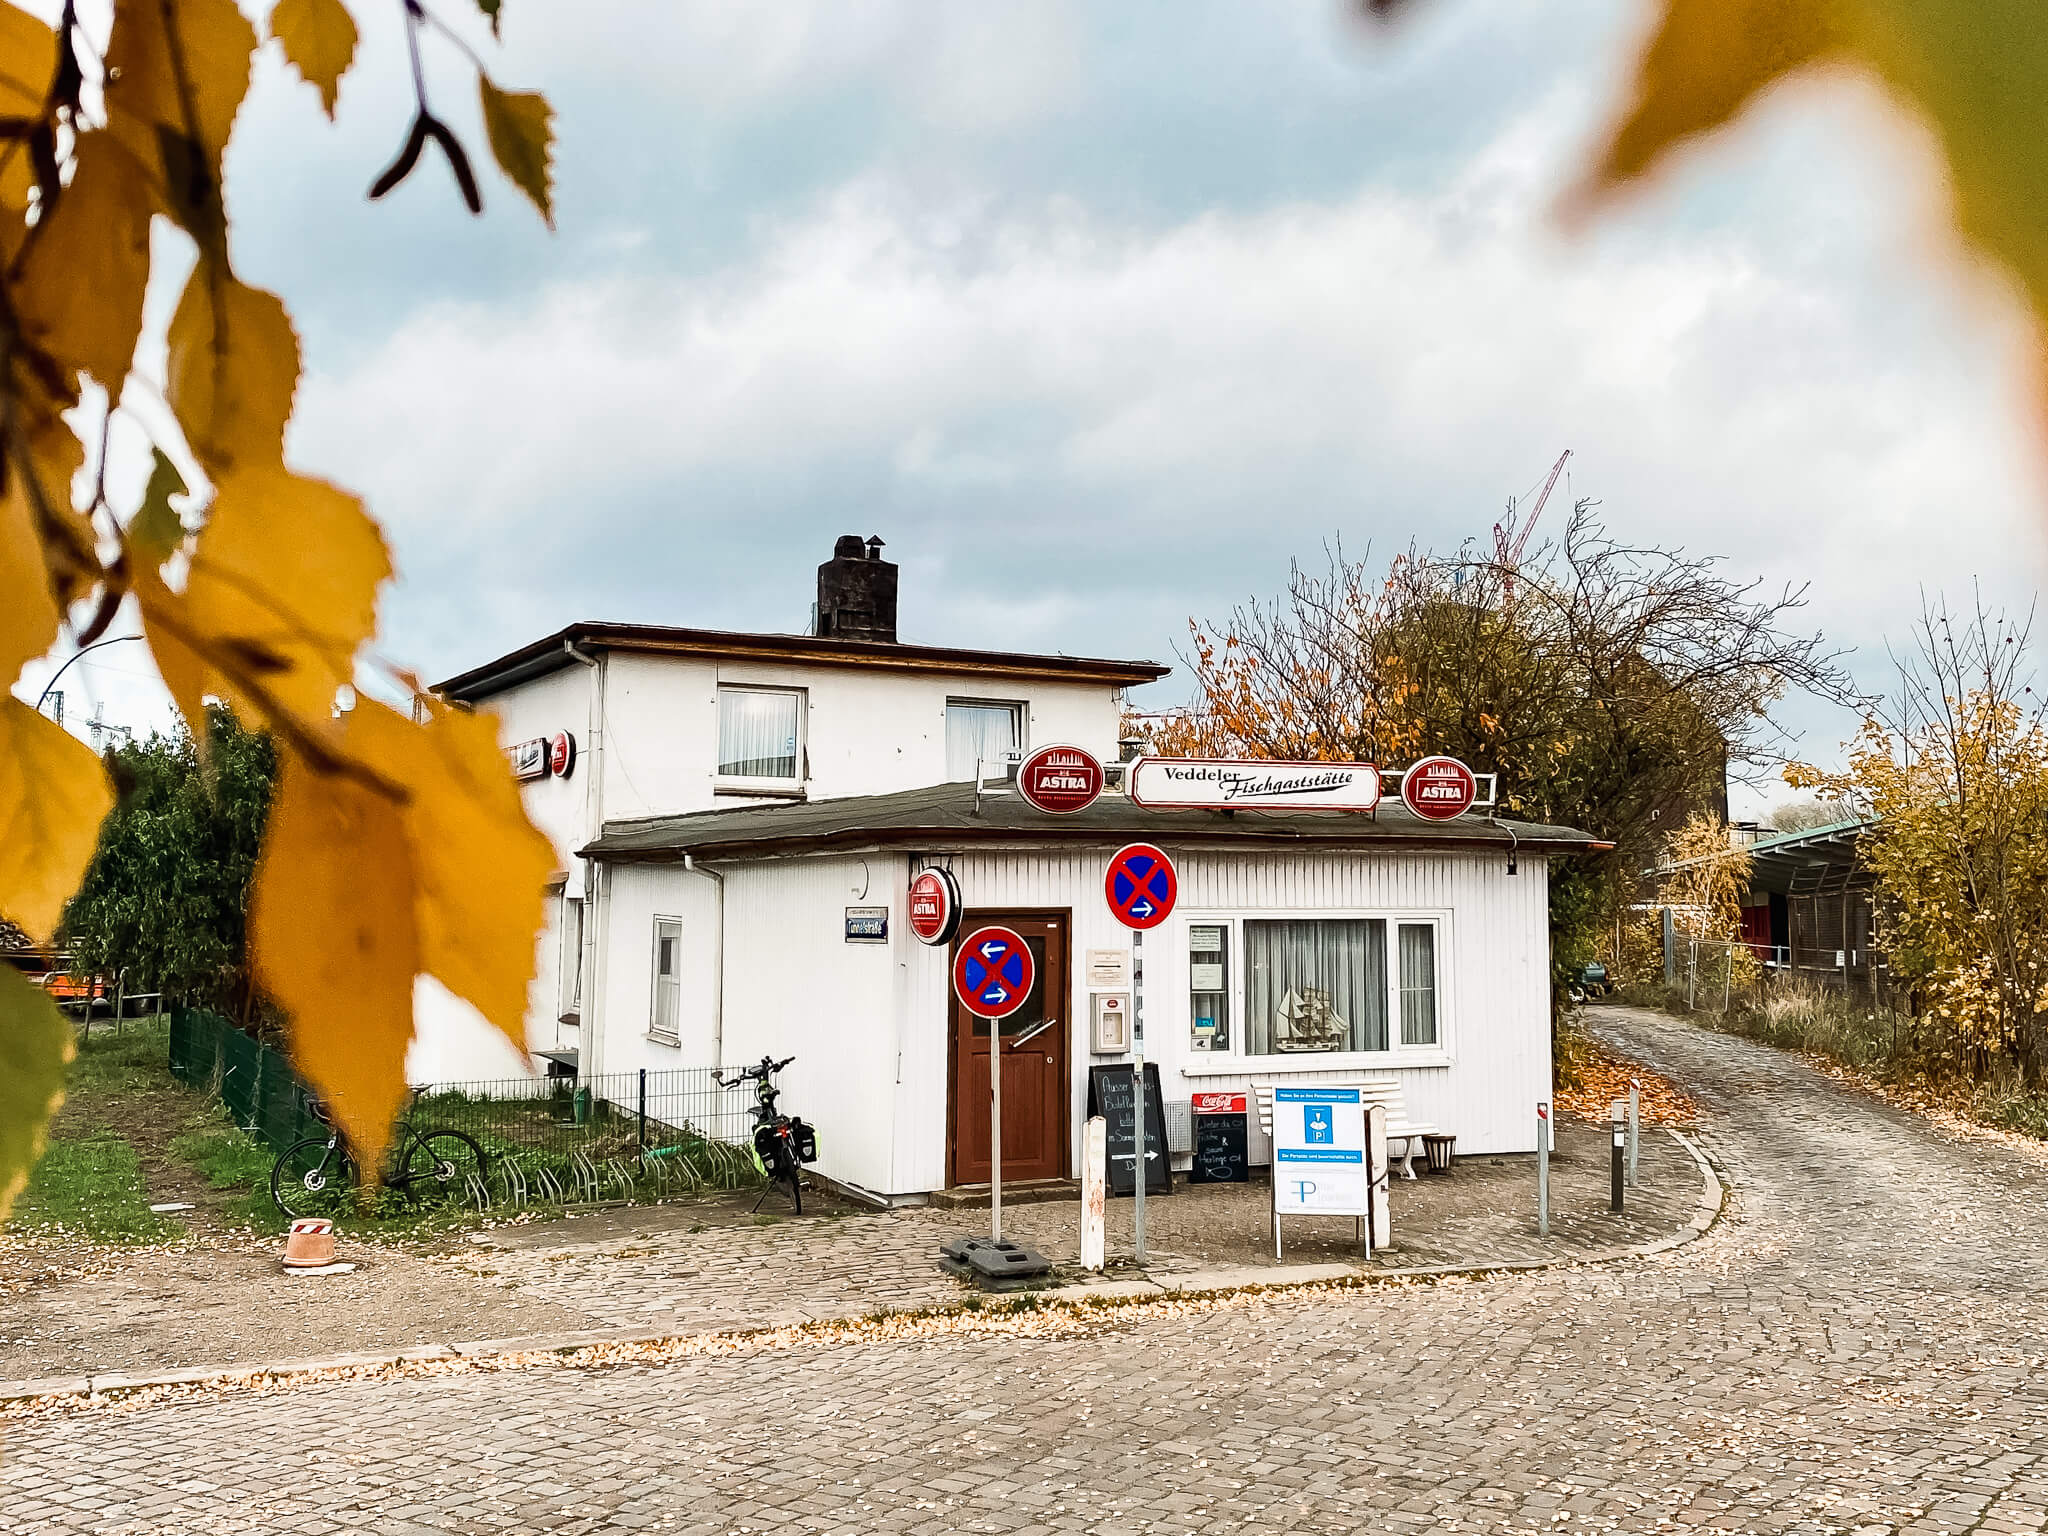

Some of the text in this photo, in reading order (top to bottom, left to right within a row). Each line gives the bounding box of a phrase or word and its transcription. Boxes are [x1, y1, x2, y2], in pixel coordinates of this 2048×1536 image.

[1164, 767, 1240, 782] Veddeler
[1039, 776, 1087, 789] ASTRA
[1219, 772, 1353, 800] Fischgaststätte
[1421, 786, 1462, 799] ASTRA
[913, 903, 937, 915] ASTRA
